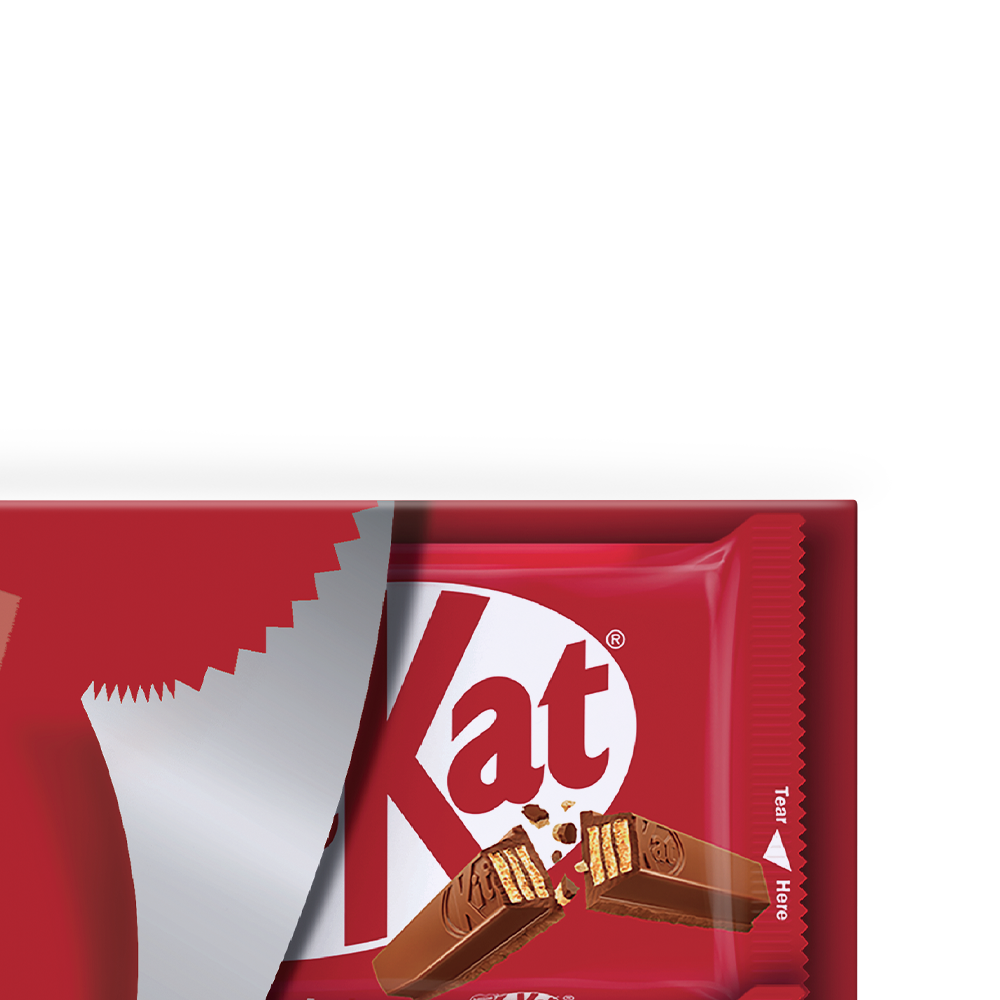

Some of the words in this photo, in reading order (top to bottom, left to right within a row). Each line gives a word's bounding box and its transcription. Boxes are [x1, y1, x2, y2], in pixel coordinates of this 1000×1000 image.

[324, 589, 609, 946] Kat
[775, 786, 789, 824] Tear
[776, 880, 790, 921] Here
